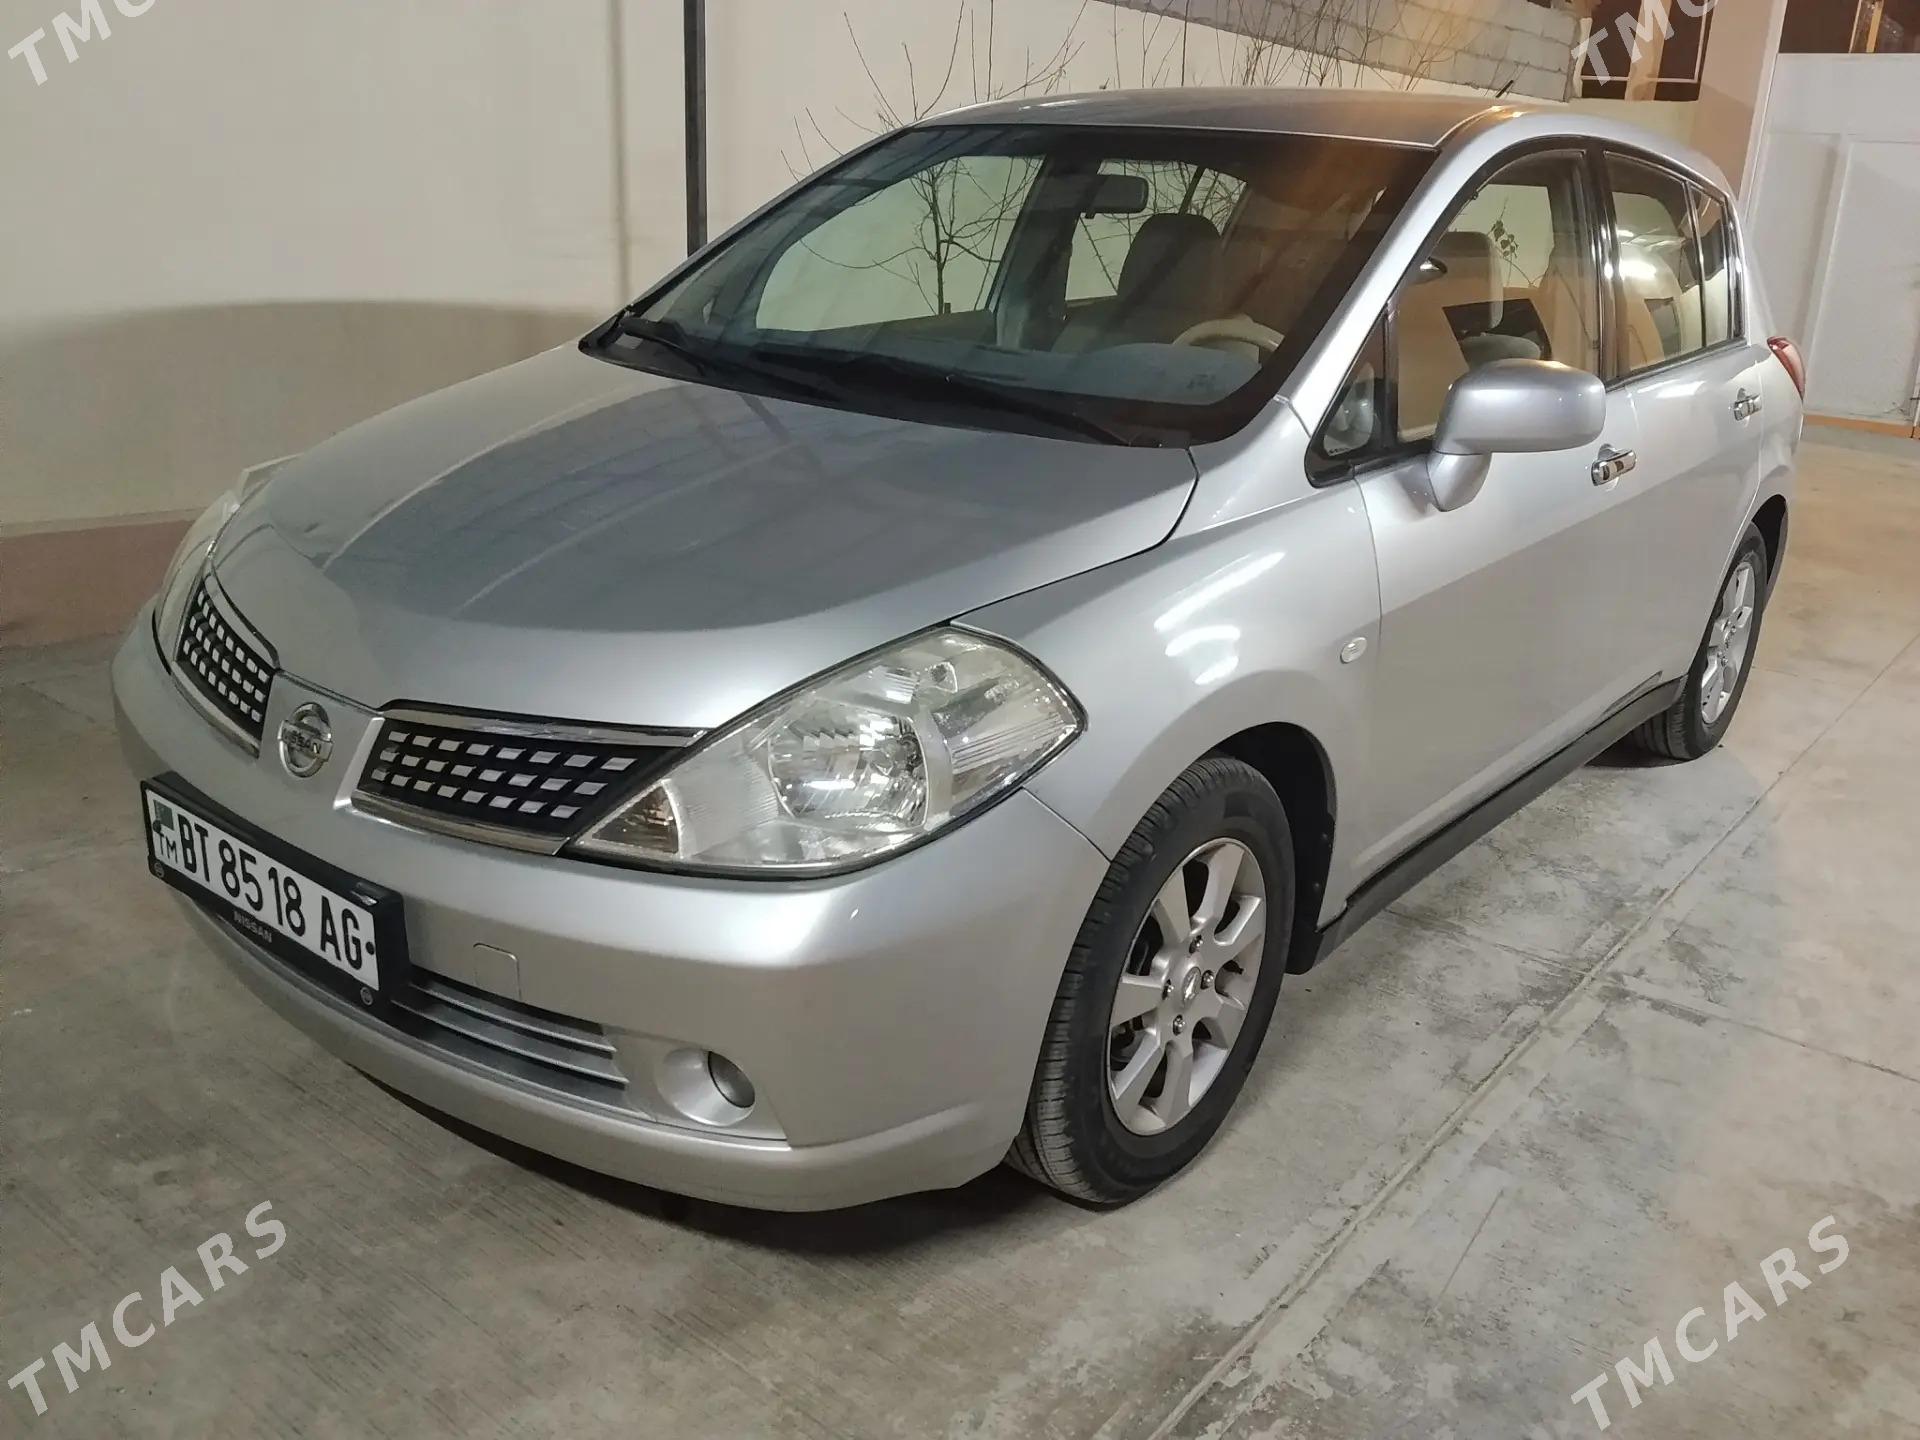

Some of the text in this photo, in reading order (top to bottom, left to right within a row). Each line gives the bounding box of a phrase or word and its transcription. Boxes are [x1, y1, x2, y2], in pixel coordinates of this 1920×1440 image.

[154, 829, 178, 864] TM
[178, 814, 363, 970] BT 8518 AG
[233, 911, 272, 943] NISSAN
